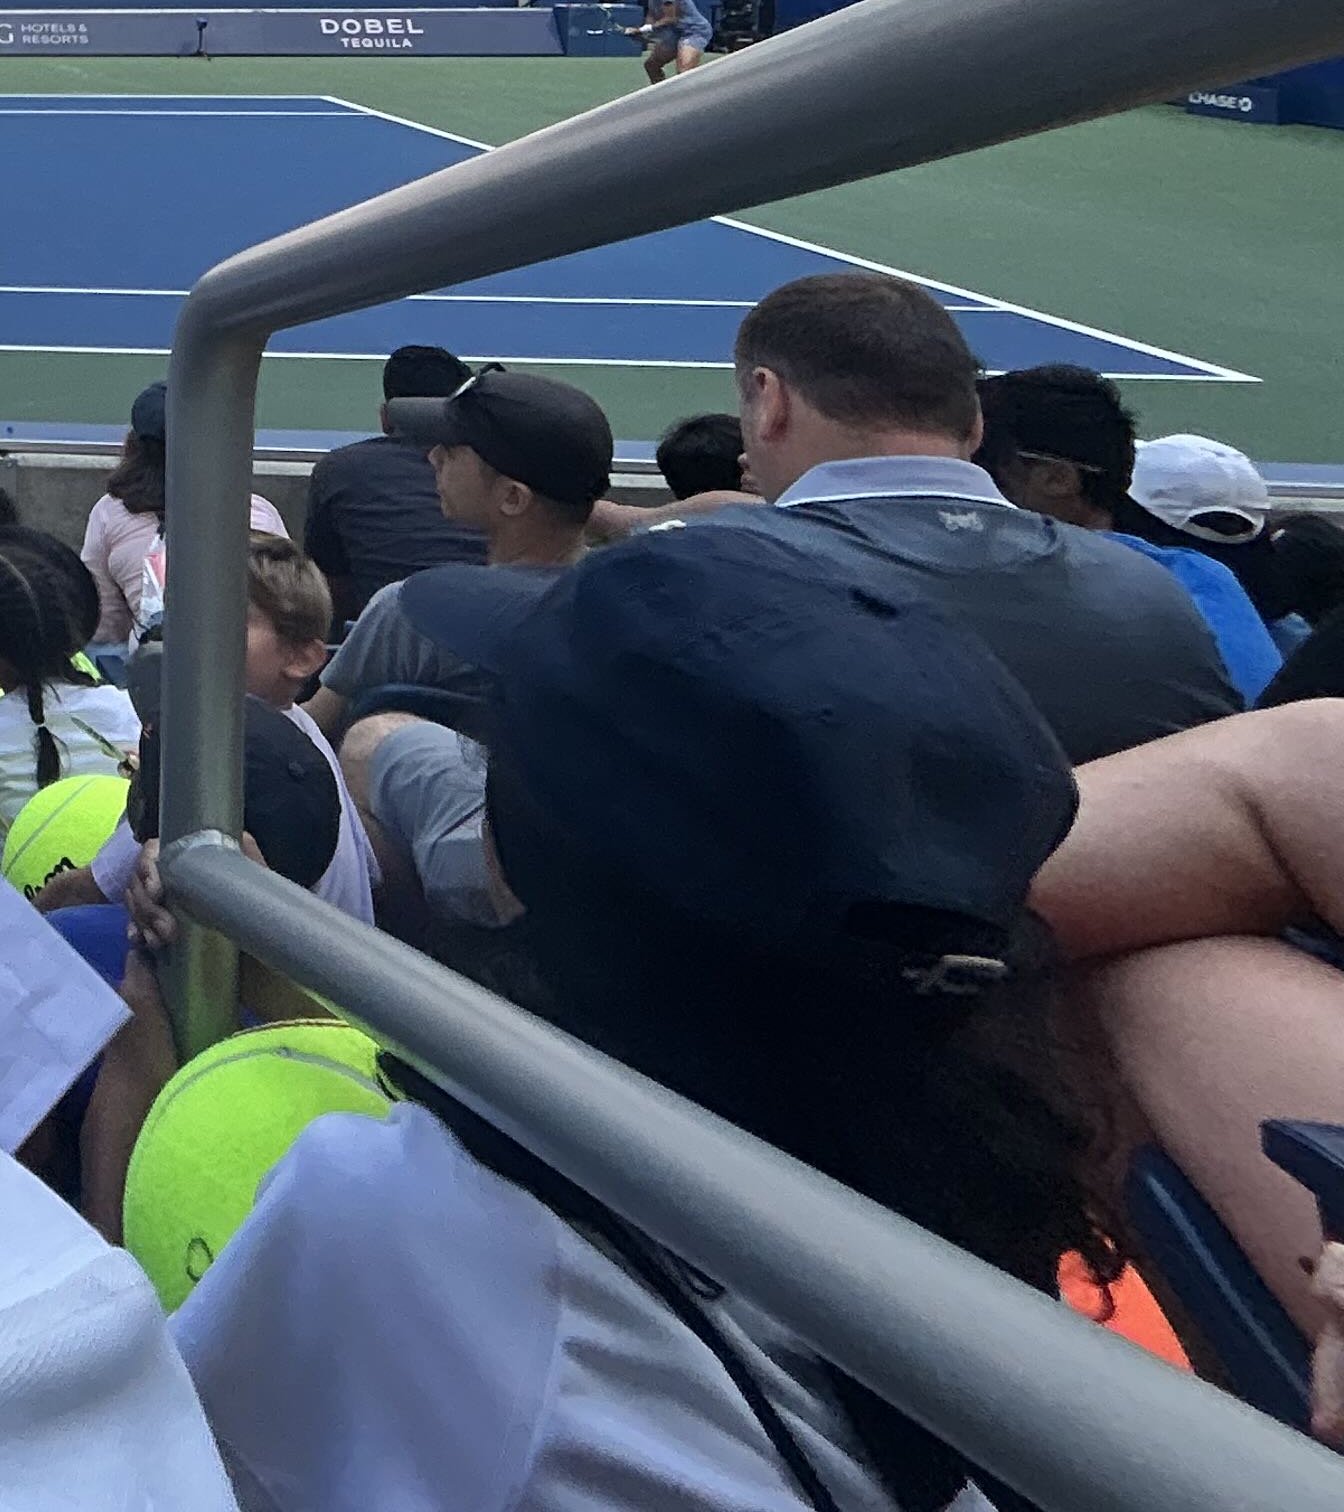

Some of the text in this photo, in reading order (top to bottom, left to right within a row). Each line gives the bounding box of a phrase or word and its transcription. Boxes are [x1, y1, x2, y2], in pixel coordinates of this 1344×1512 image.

[21, 23, 76, 33] HOTELS
[320, 18, 424, 35] DOBEL
[22, 34, 89, 45] RESORTS
[341, 37, 412, 48] TEQUILA
